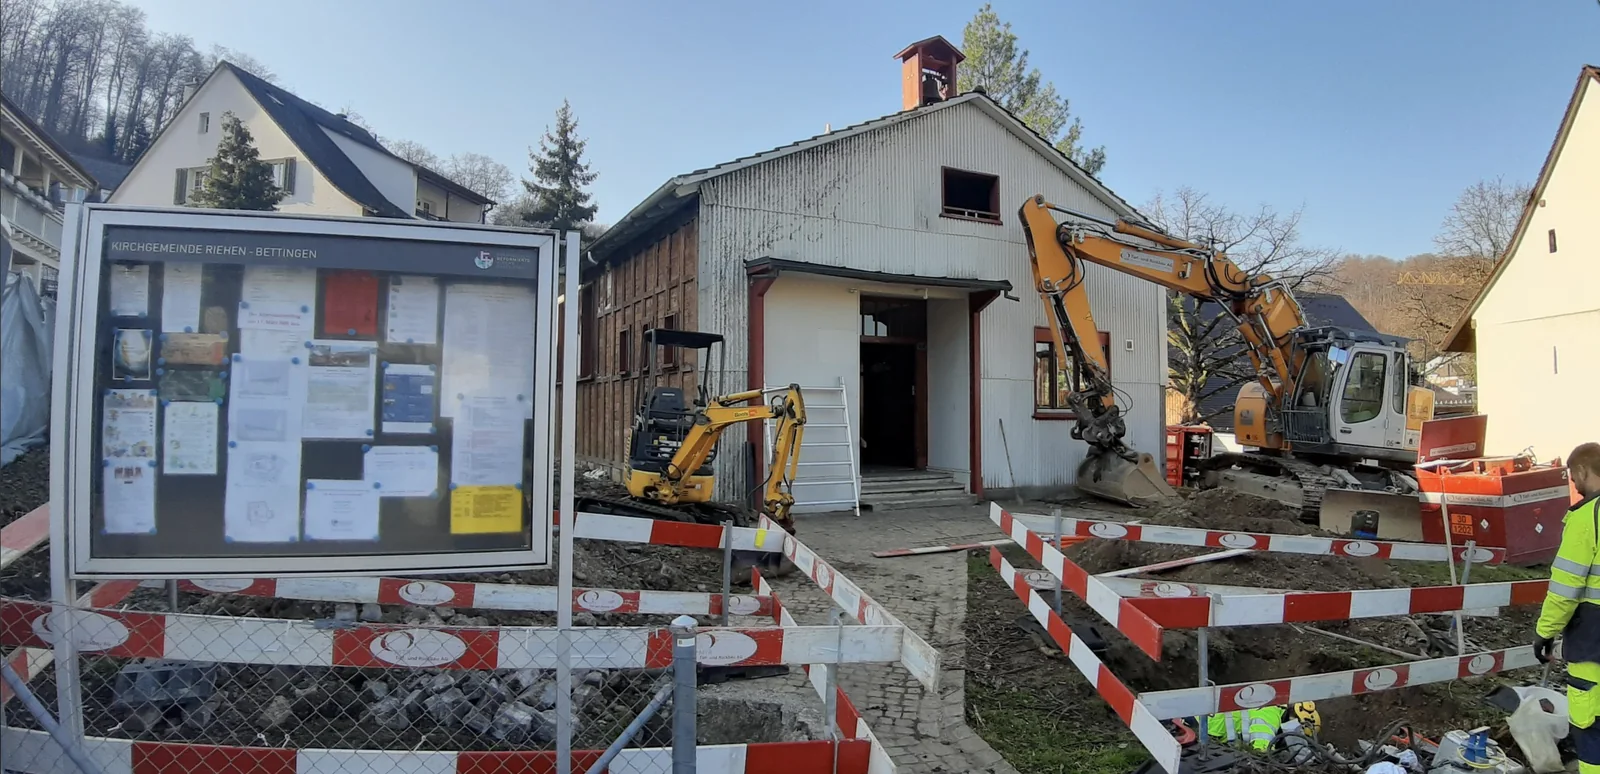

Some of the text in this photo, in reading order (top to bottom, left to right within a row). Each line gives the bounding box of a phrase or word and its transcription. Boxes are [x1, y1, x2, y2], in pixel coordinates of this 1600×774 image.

[111, 241, 203, 254] KIRCHGEMEINDE
[205, 245, 246, 256] RIEHEN
[255, 247, 317, 259] BETTINGEN
[1561, 470, 1567, 480] 2
[1454, 525, 1471, 534] 1202
